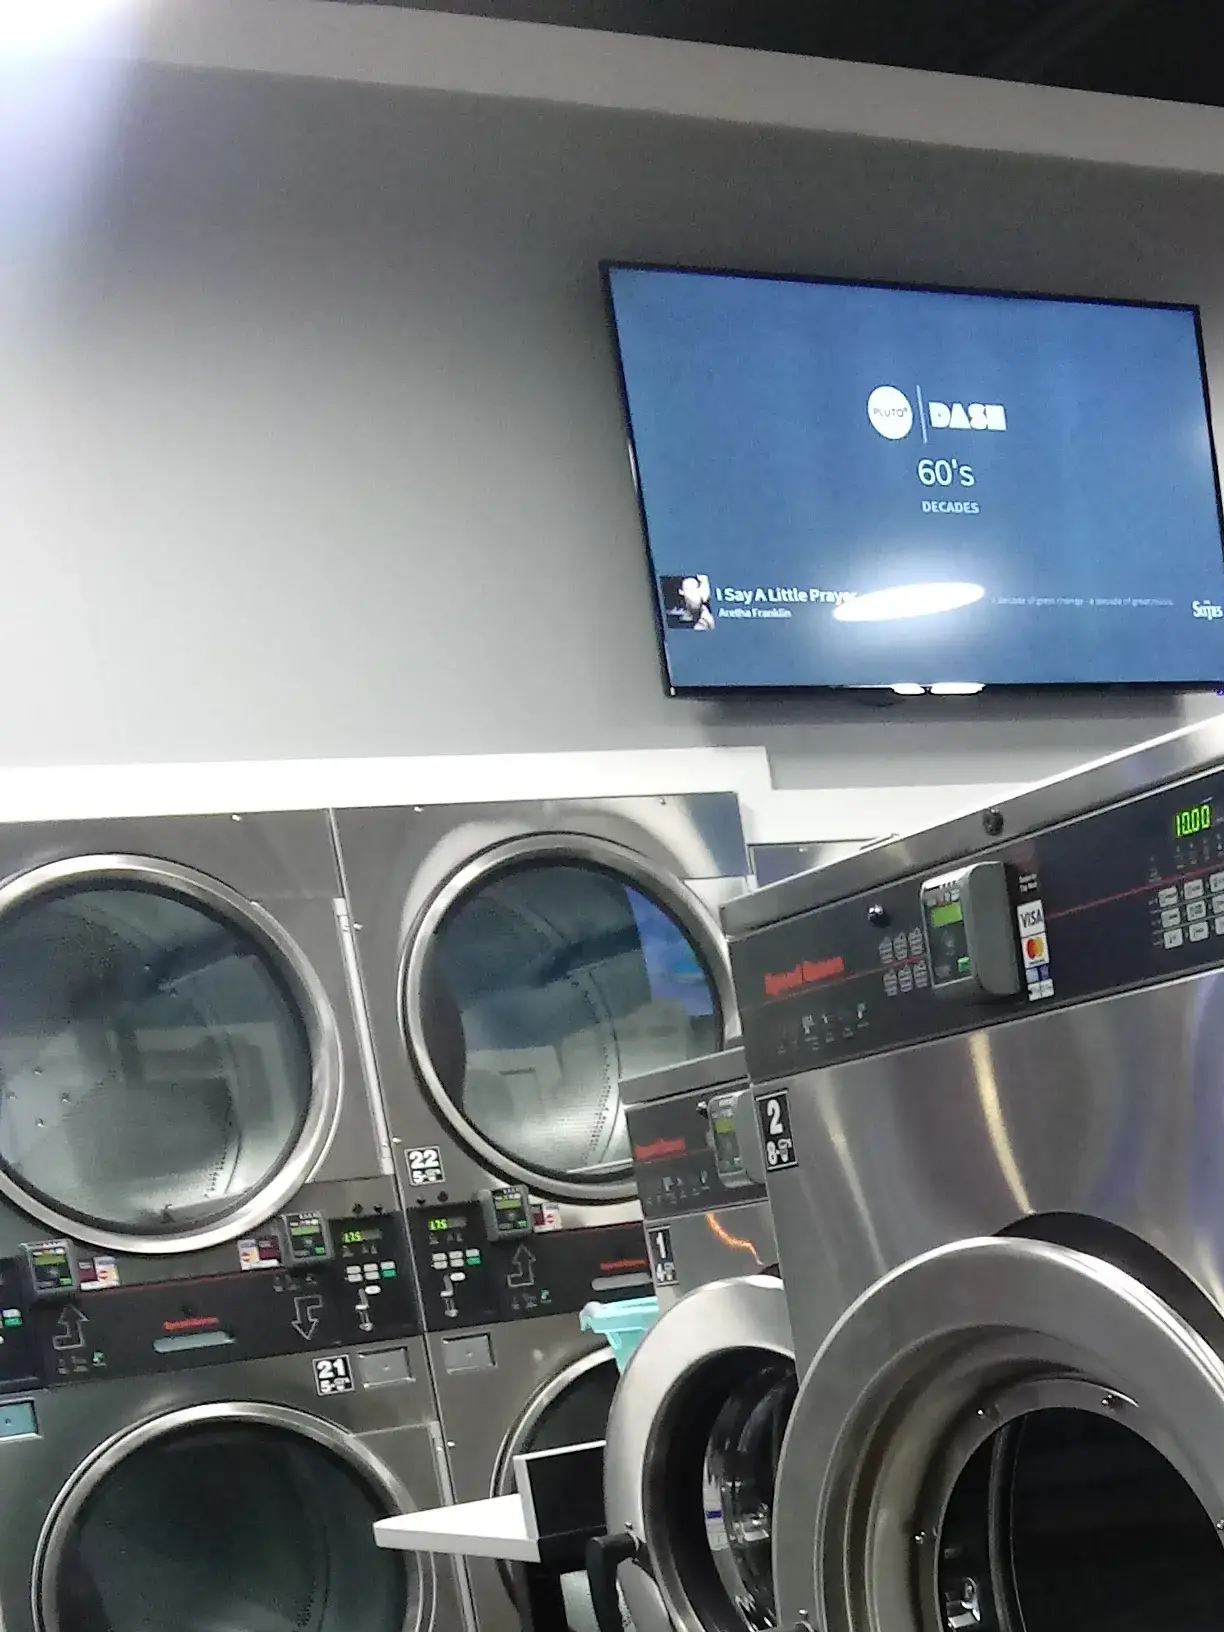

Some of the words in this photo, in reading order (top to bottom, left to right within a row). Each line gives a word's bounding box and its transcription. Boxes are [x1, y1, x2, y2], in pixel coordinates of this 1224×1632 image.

[928, 402, 1007, 431] DASH
[918, 459, 975, 486] 60's
[922, 500, 980, 514] DECADES
[724, 588, 752, 605] Say
[755, 588, 767, 601] A
[768, 587, 808, 602] Little
[1020, 909, 1043, 928] VISA
[767, 1099, 783, 1135] 2
[409, 1150, 440, 1169] 22
[656, 1231, 666, 1259] 1
[316, 1359, 346, 1379] 21
